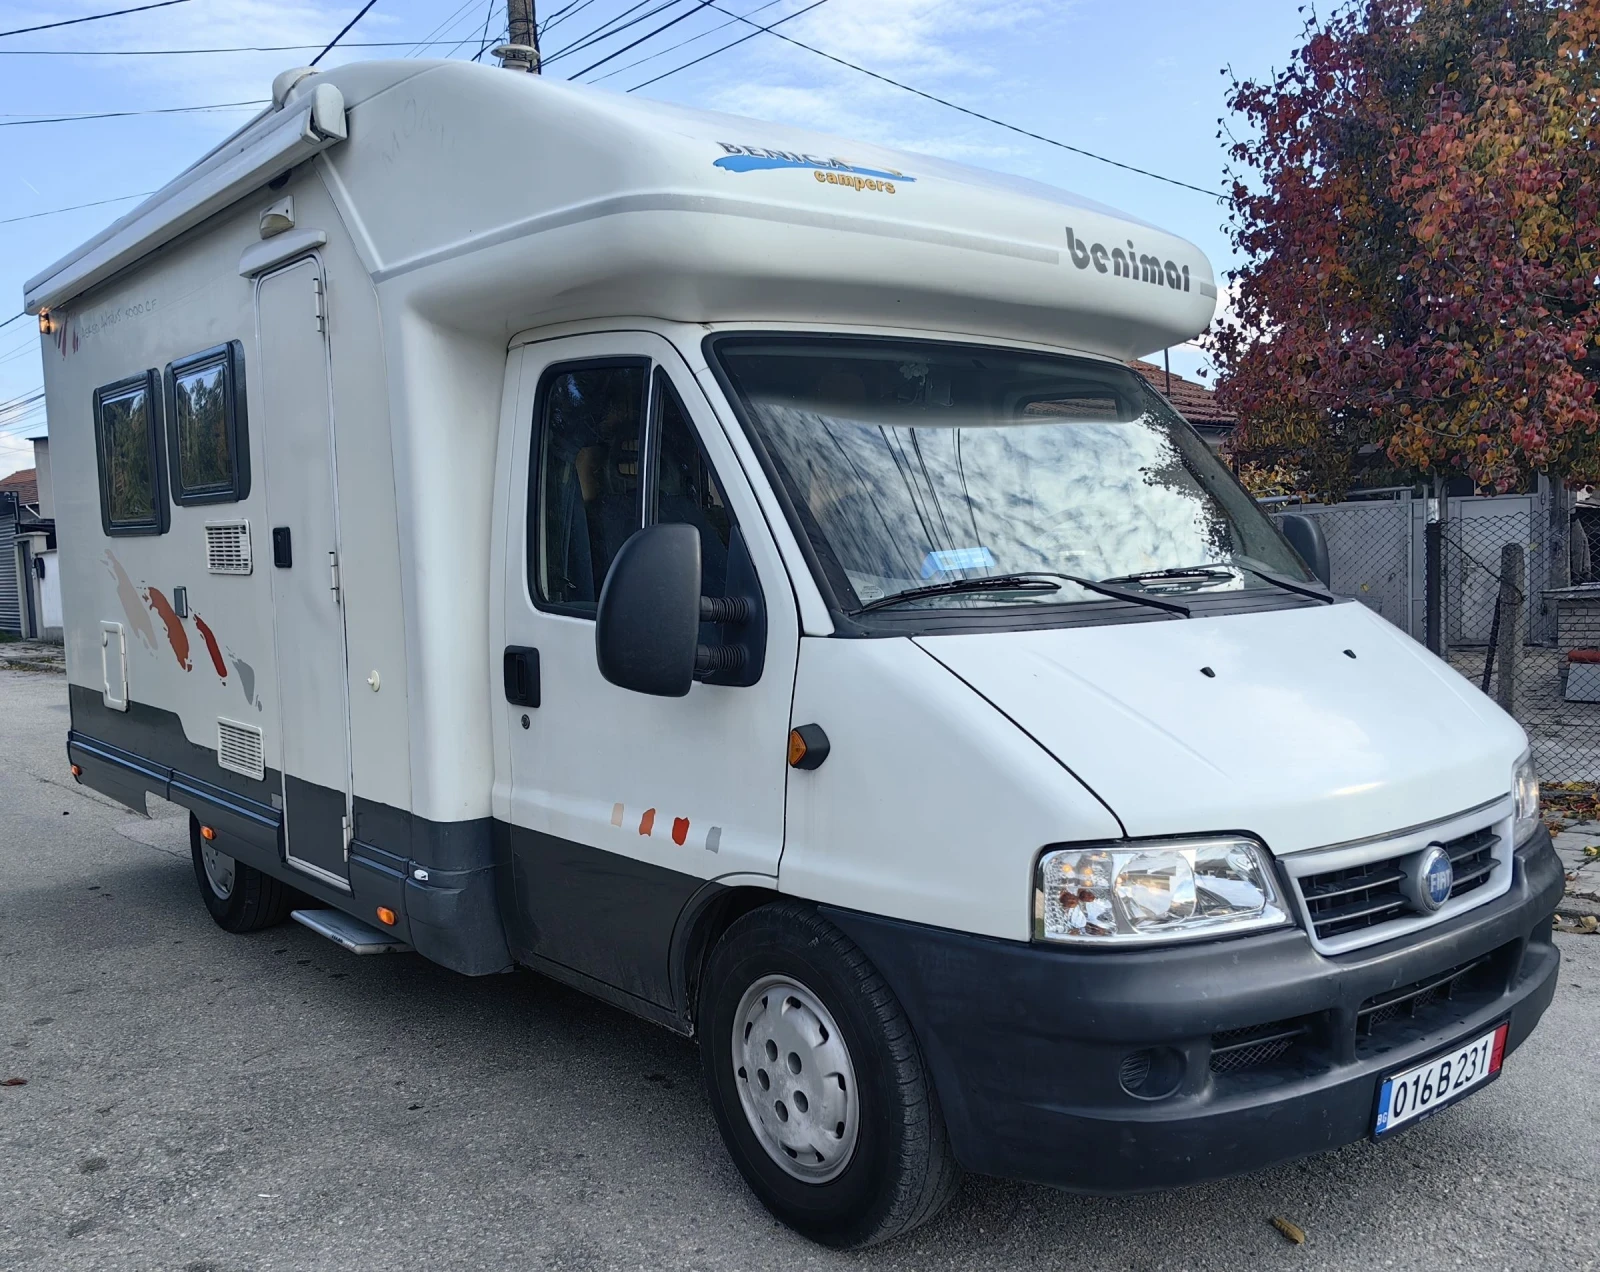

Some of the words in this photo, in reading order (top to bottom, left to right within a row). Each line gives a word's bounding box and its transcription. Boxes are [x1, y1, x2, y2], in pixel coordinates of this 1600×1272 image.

[813, 170, 896, 195] campers
[1430, 869, 1451, 893] FIAT
[1376, 1111, 1388, 1126] BG
